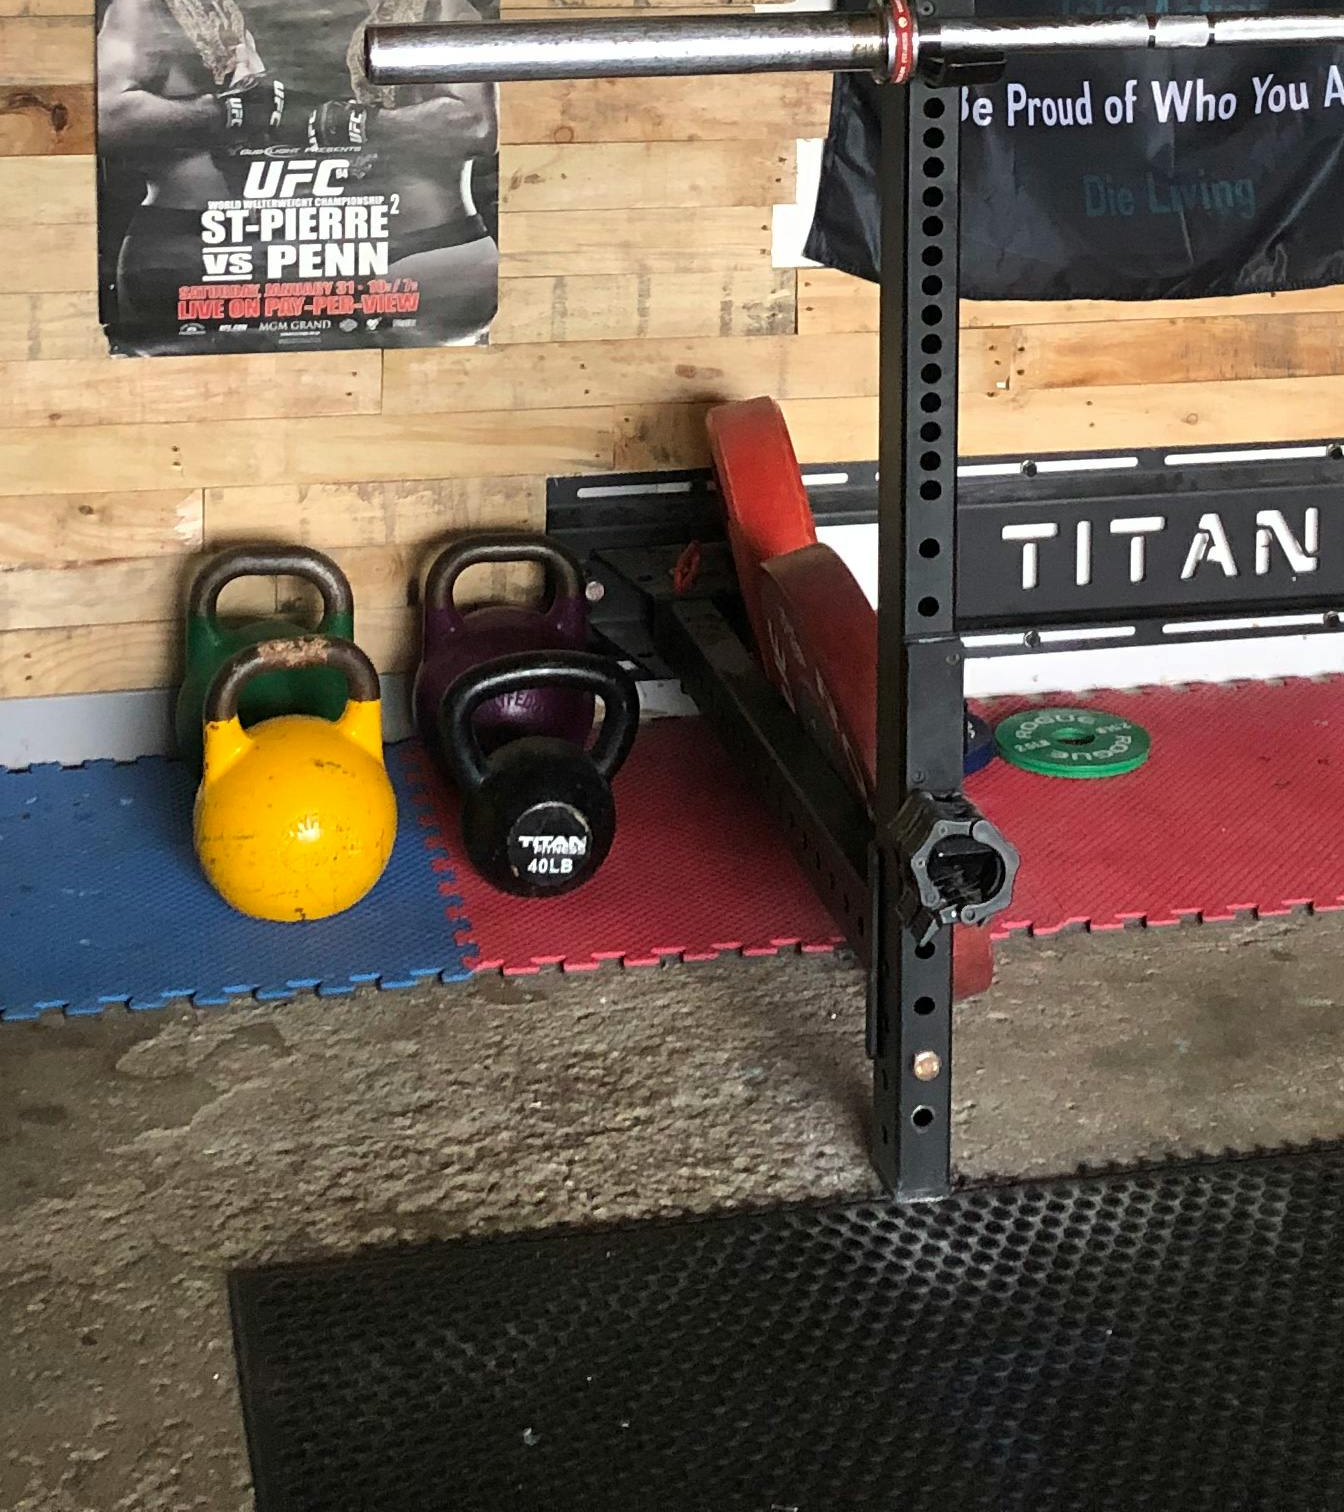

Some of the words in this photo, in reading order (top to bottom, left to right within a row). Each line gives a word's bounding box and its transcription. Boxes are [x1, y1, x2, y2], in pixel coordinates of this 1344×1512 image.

[1006, 81, 1093, 127] Proud
[1104, 79, 1138, 123] of
[1151, 78, 1237, 124] Who
[1252, 73, 1309, 115] You
[243, 159, 350, 199] UFC
[208, 200, 242, 210] WORLD
[243, 197, 314, 209] WELTERWEIGHT
[314, 195, 385, 207] CHAMPIONSHIP
[1083, 172, 1136, 216] Die
[1148, 169, 1256, 220] Living
[201, 205, 389, 245] ST-PIERRE
[390, 193, 401, 215] 2
[202, 252, 254, 275] VS
[267, 241, 389, 279] PENN
[264, 281, 334, 297] JANUARY
[336, 280, 354, 294] 31
[177, 299, 225, 320] LIVE
[229, 298, 261, 319] ON
[264, 292, 420, 317] PAY-PER-VIEW
[258, 321, 290, 332] MGM
[291, 319, 332, 331] GRAND
[1001, 506, 1320, 590] TITAN
[1016, 714, 1095, 739] ROGUE
[1050, 735, 1132, 761] ROGUE
[518, 835, 587, 848] TITAN
[527, 857, 573, 874] 40LB
